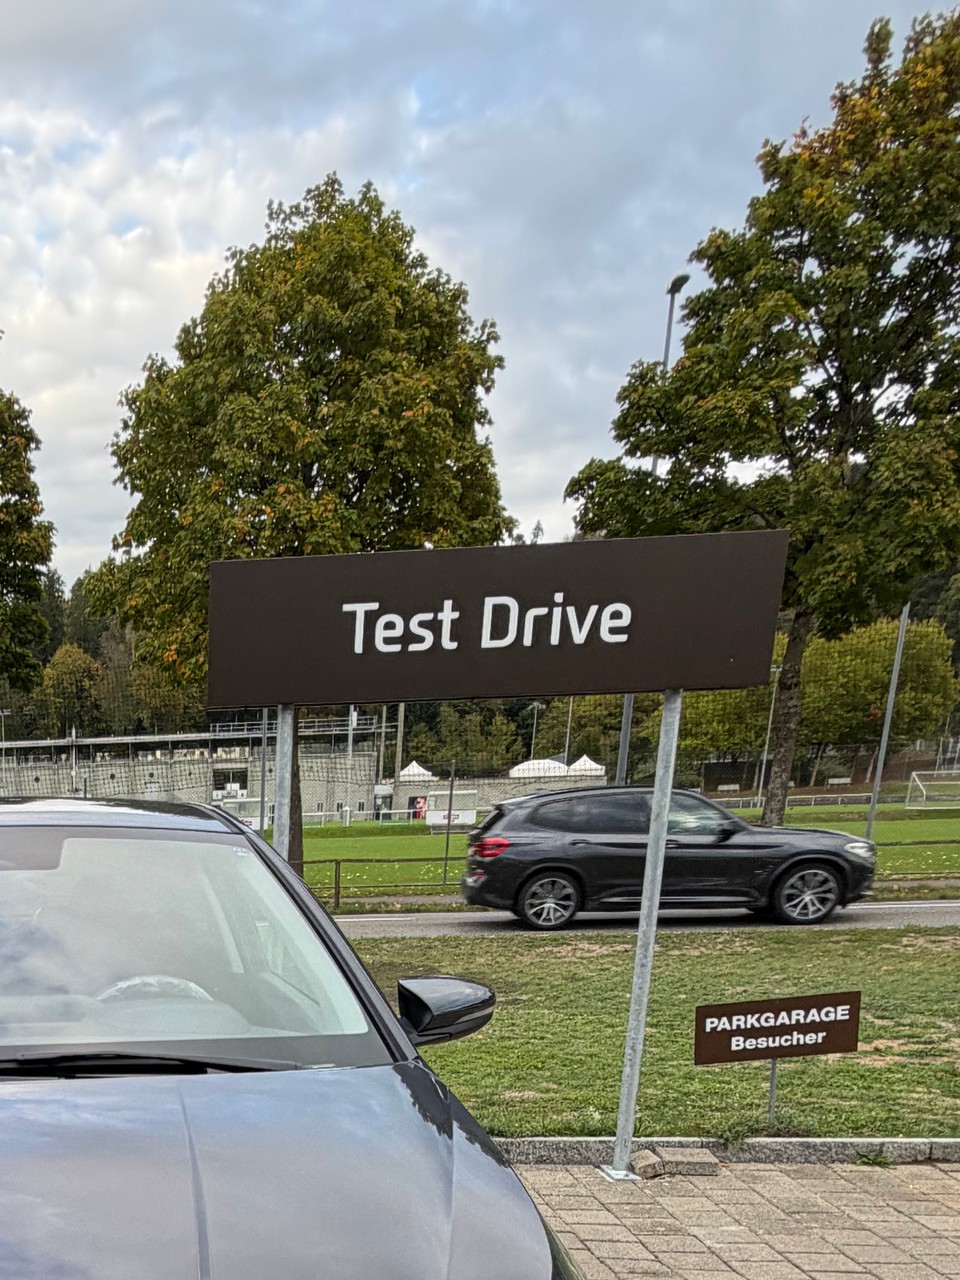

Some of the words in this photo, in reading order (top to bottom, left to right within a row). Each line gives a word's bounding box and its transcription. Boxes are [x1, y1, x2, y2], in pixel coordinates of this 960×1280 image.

[342, 599, 460, 654] Test
[481, 592, 632, 648] Drive
[705, 1005, 851, 1032] PARKGARAGE
[731, 1031, 827, 1051] Besucher
